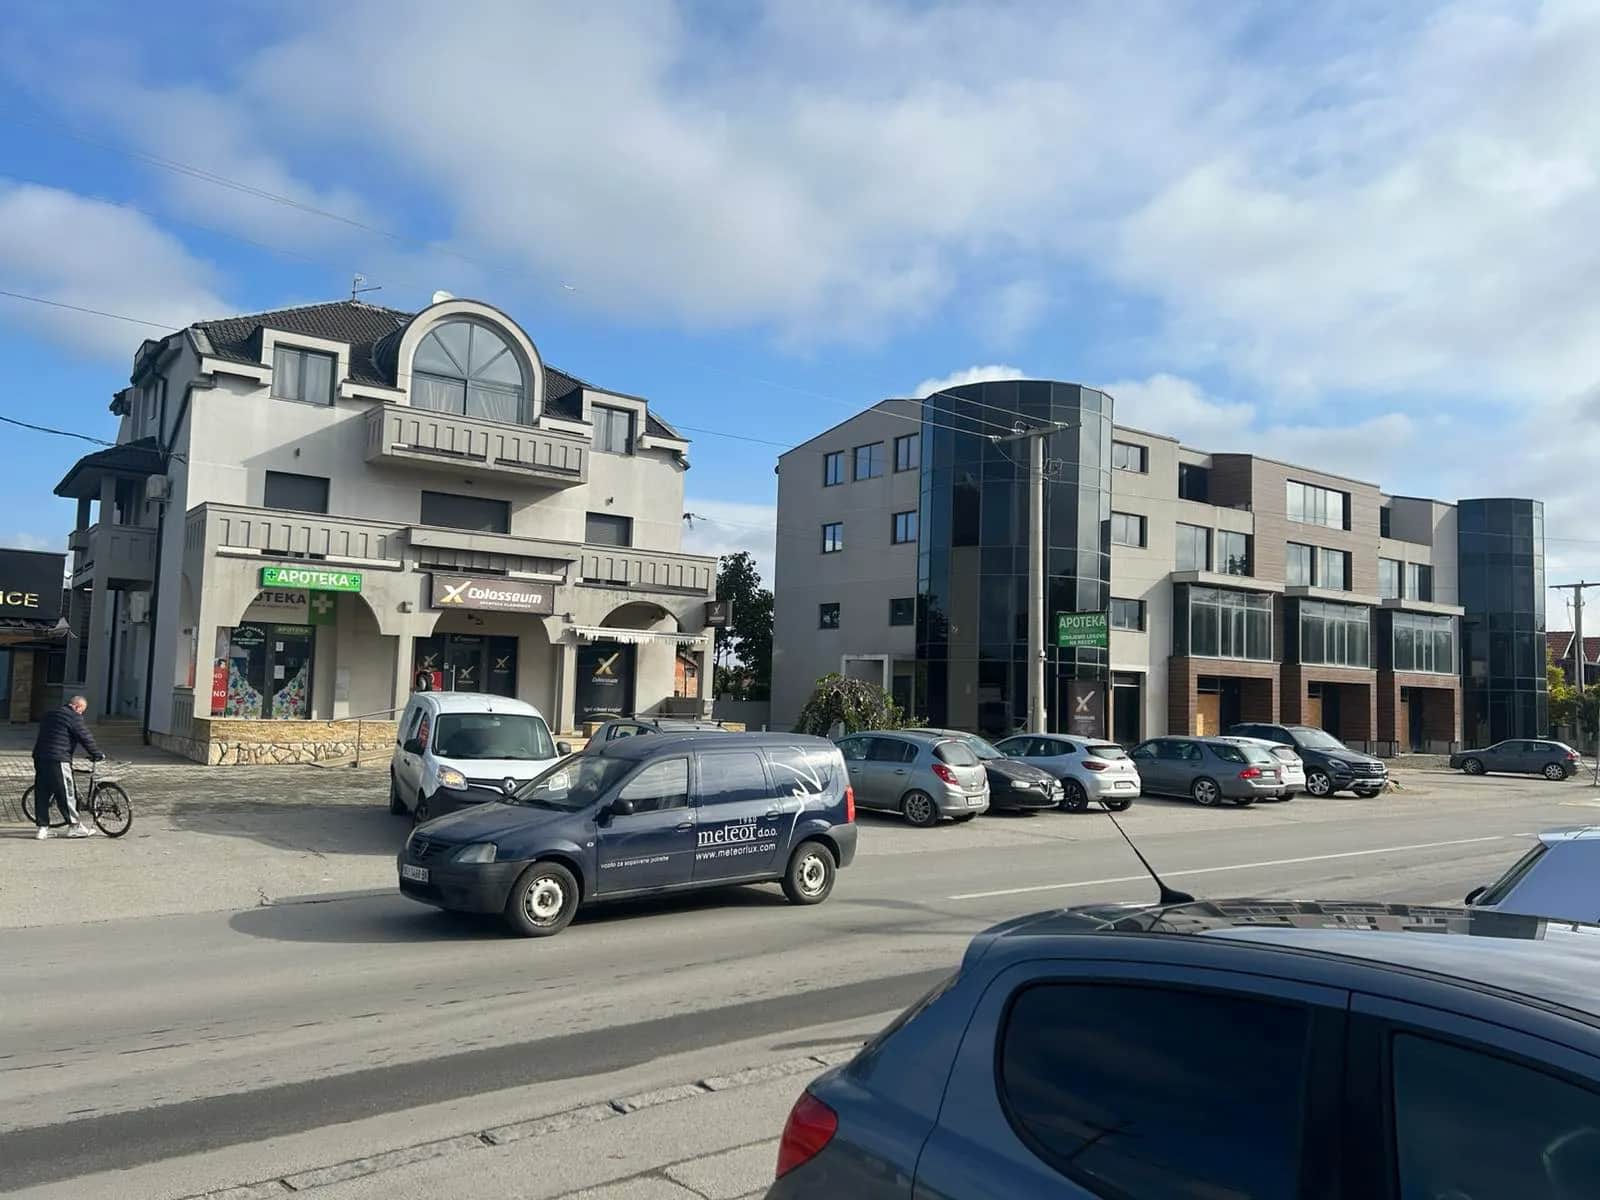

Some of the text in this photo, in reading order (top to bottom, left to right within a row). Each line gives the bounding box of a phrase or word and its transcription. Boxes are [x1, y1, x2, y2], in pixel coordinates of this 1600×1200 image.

[278, 570, 349, 586] APOTEKA
[468, 587, 542, 604] Colosseum
[1059, 615, 1106, 628] APOTEKA
[697, 824, 778, 845] meteor d.o.o.
[695, 843, 776, 861] www.meteorlux.com
